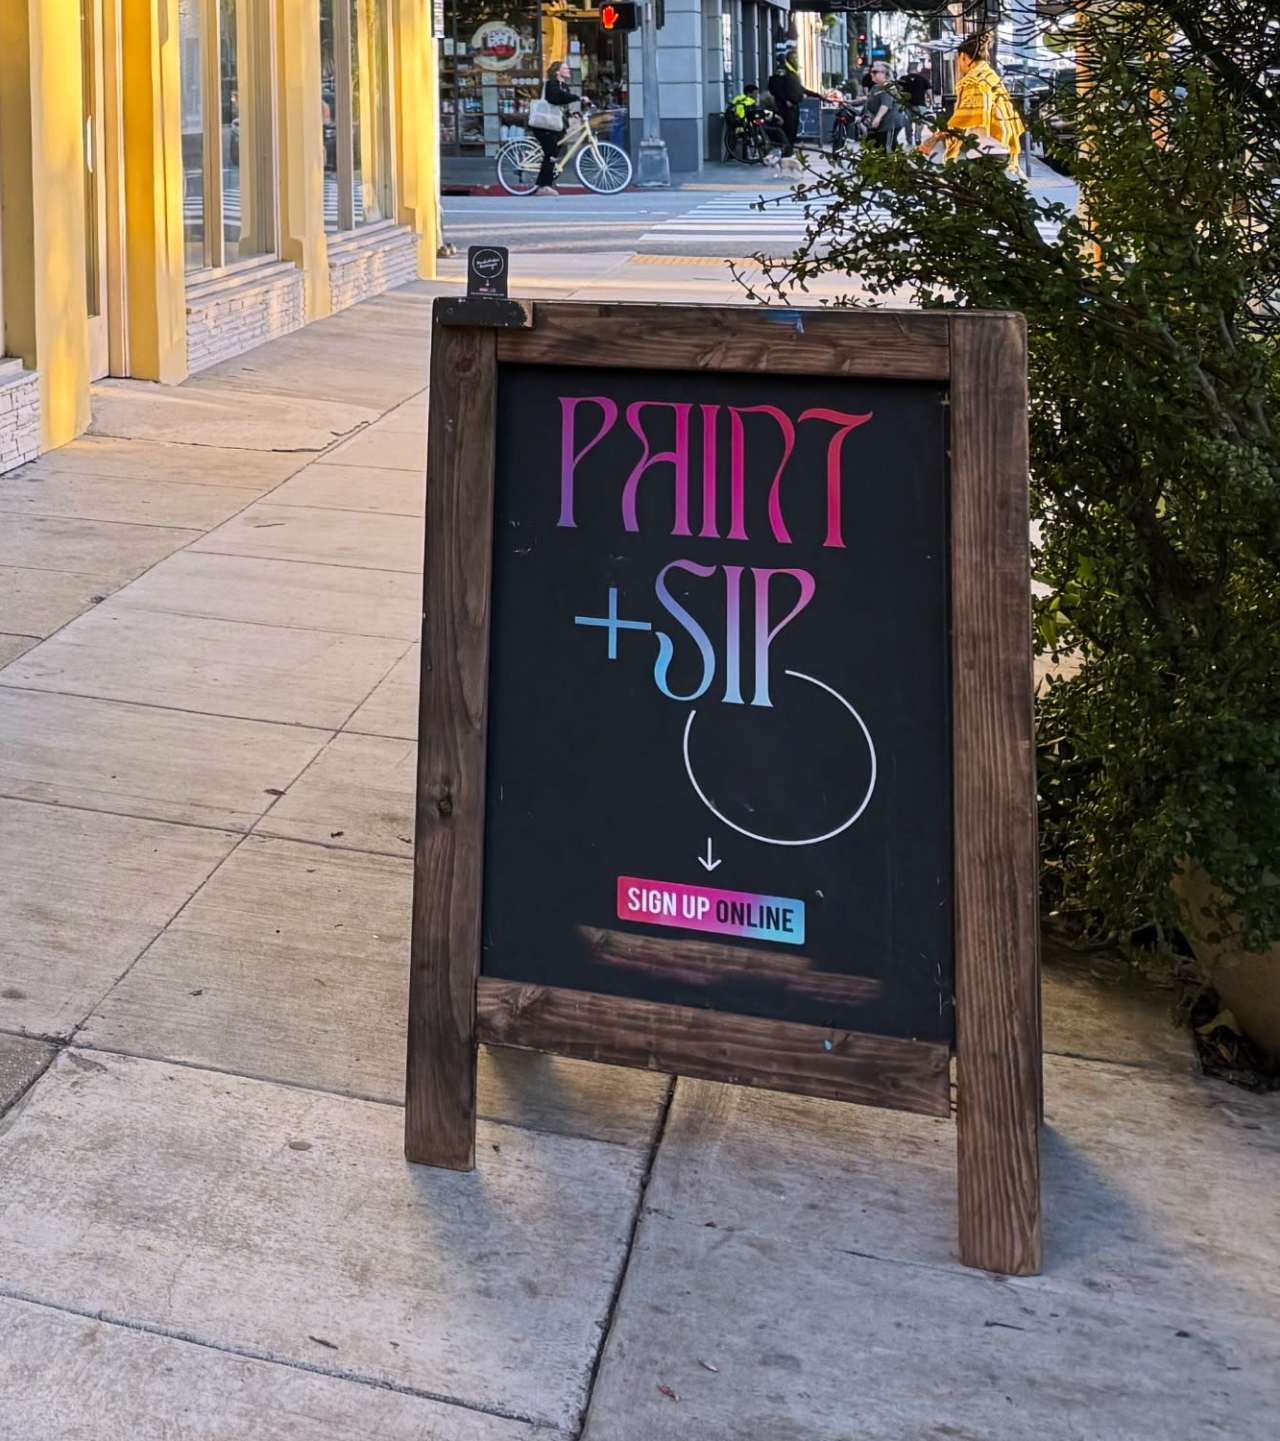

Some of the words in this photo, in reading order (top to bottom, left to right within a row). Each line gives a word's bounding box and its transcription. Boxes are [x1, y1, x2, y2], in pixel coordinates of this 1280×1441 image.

[556, 396, 873, 547] PAINT
[627, 887, 676, 916] SIGN
[682, 894, 710, 920] UP
[716, 899, 794, 932] ONLINE
